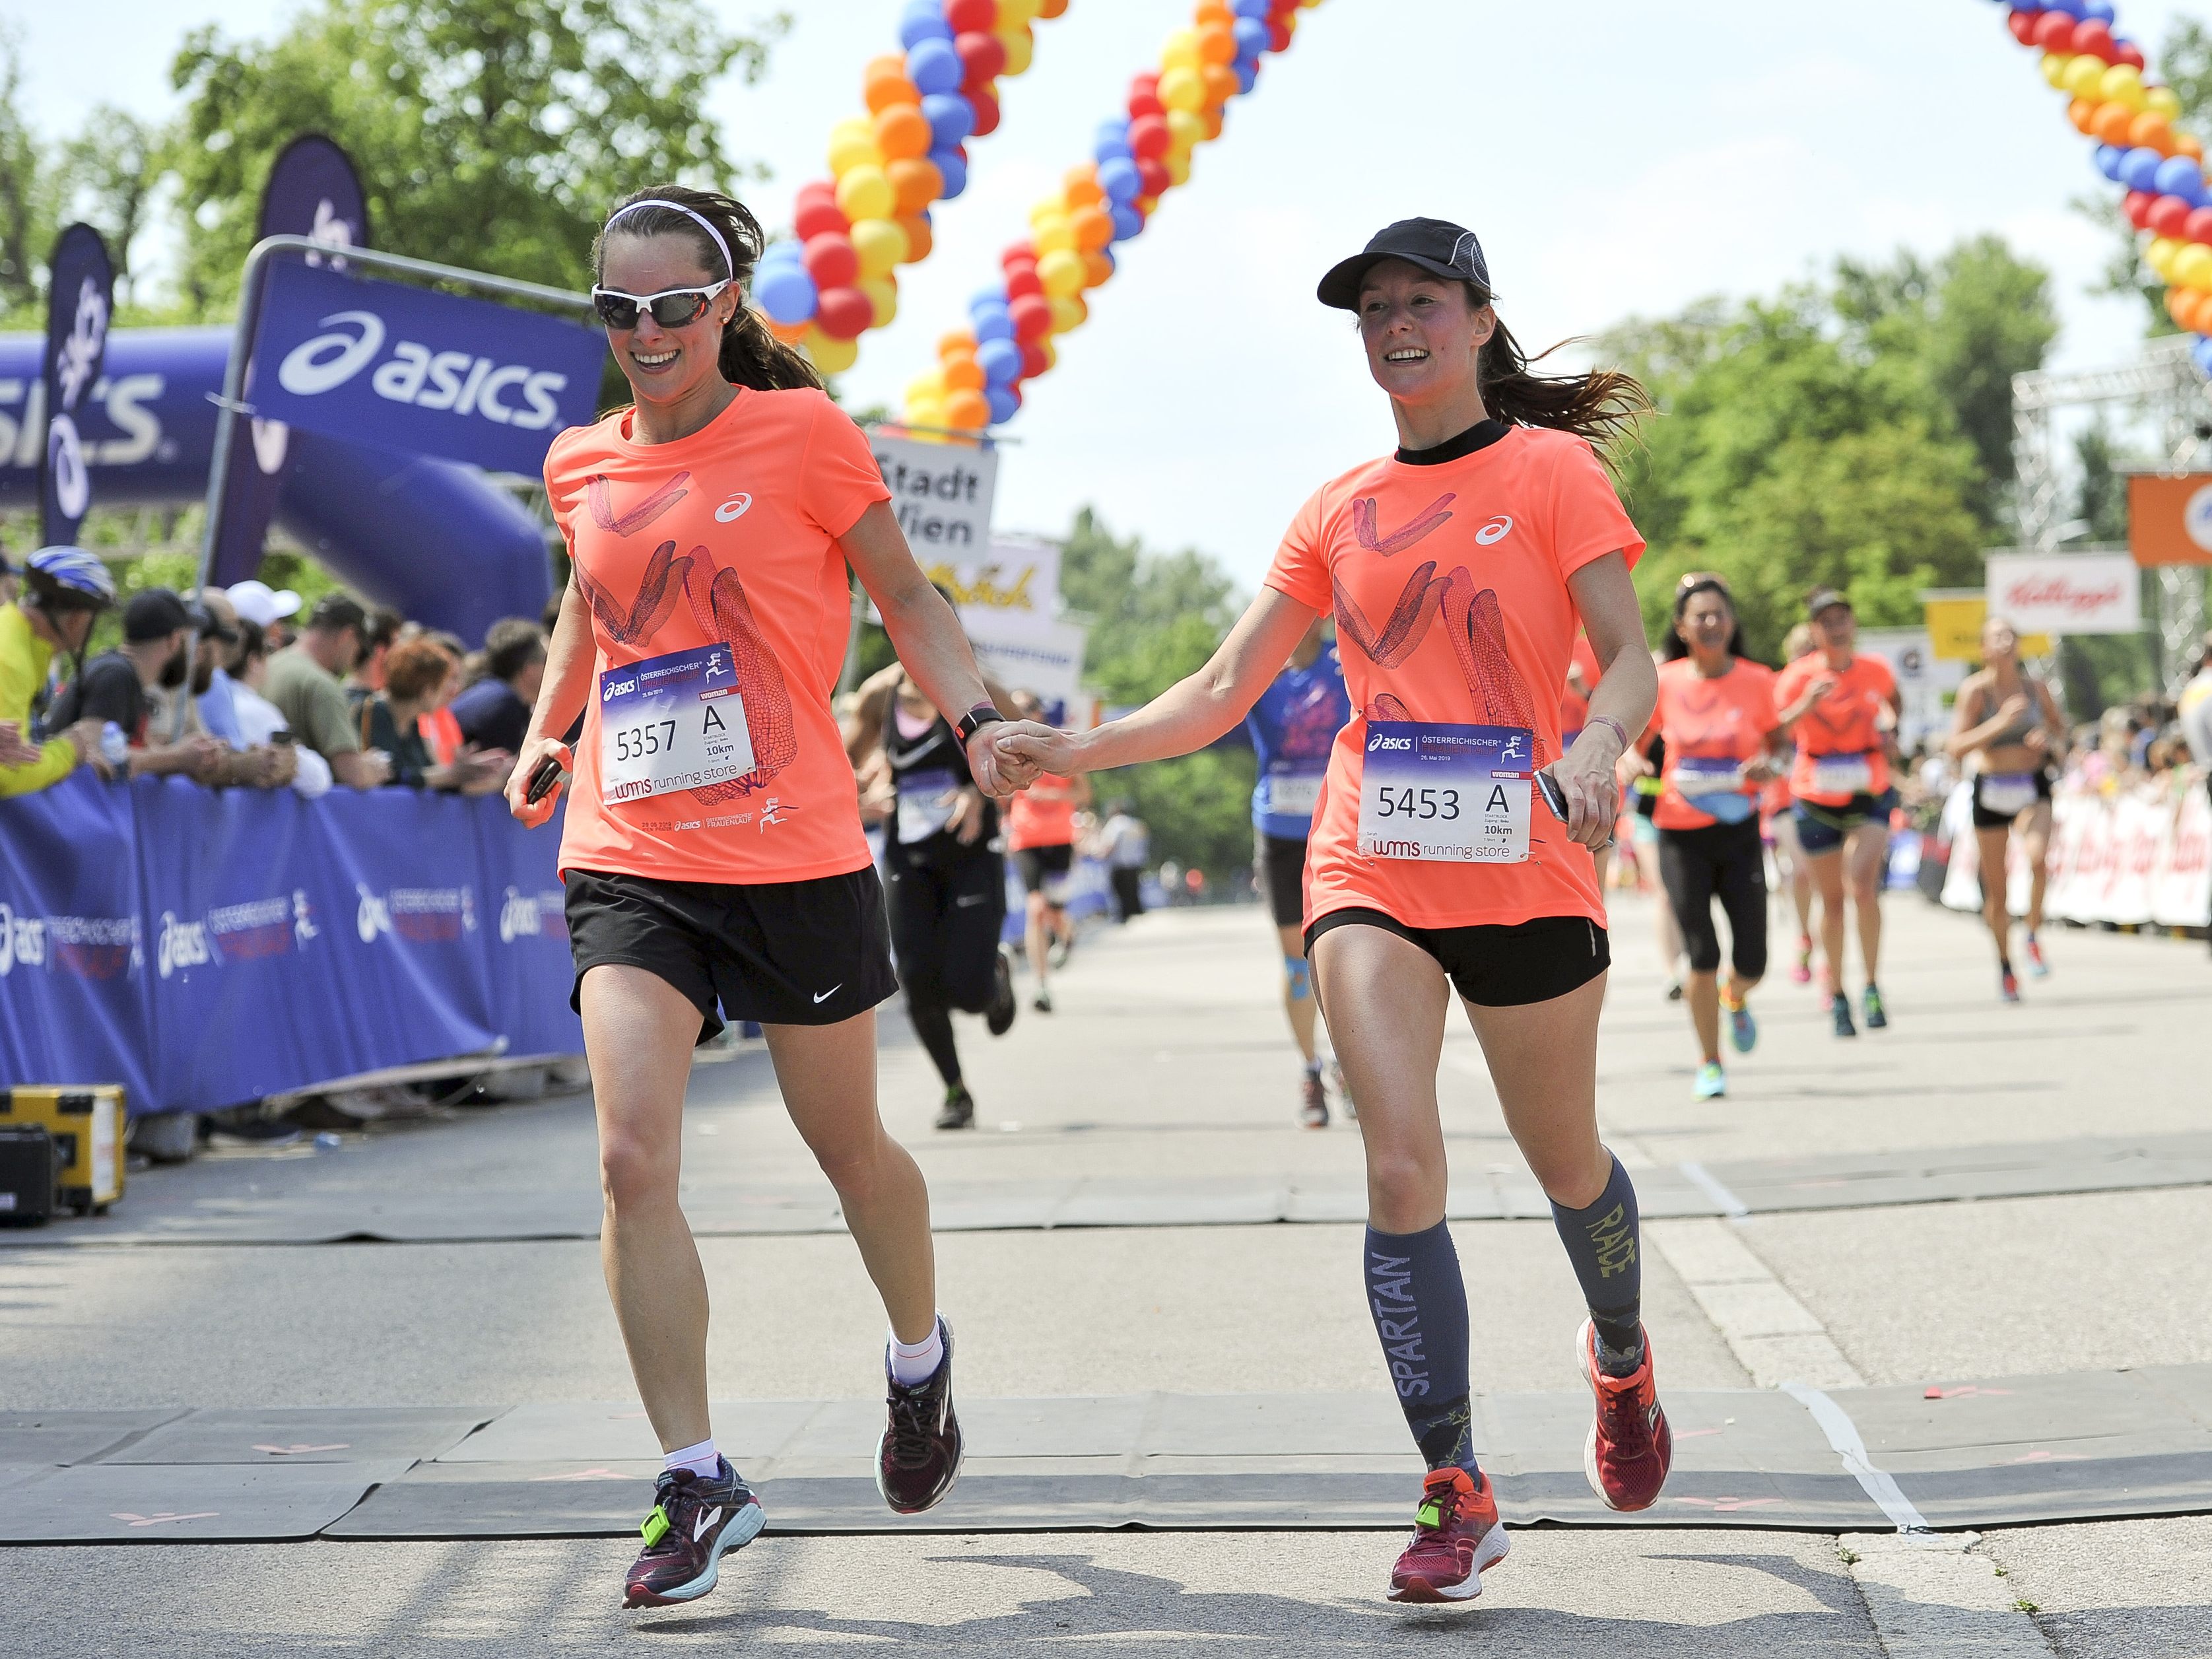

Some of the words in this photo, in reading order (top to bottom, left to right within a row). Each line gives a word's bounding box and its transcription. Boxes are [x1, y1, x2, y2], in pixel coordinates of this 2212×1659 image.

[372, 341, 568, 430] asics
[640, 662, 700, 681] ÖSTERREICHISCHER
[614, 679, 635, 696] asics
[617, 720, 676, 761] 5357
[702, 705, 726, 734] A
[1421, 735, 1498, 747] ÖSTERREICHISCHER
[706, 744, 734, 756] 10km
[1381, 737, 1412, 750] asics
[654, 772, 702, 790] running
[704, 764, 737, 780] store
[1378, 787, 1459, 820] 5453
[1485, 784, 1510, 813] A
[681, 821, 701, 829] asics
[707, 817, 753, 829] FRAUENLAUF
[1485, 825, 1512, 834] 10km
[1423, 844, 1473, 859] running
[1475, 846, 1510, 857] store
[1586, 1202, 1636, 1279] RACE
[1371, 1251, 1430, 1398] SPARTAN
